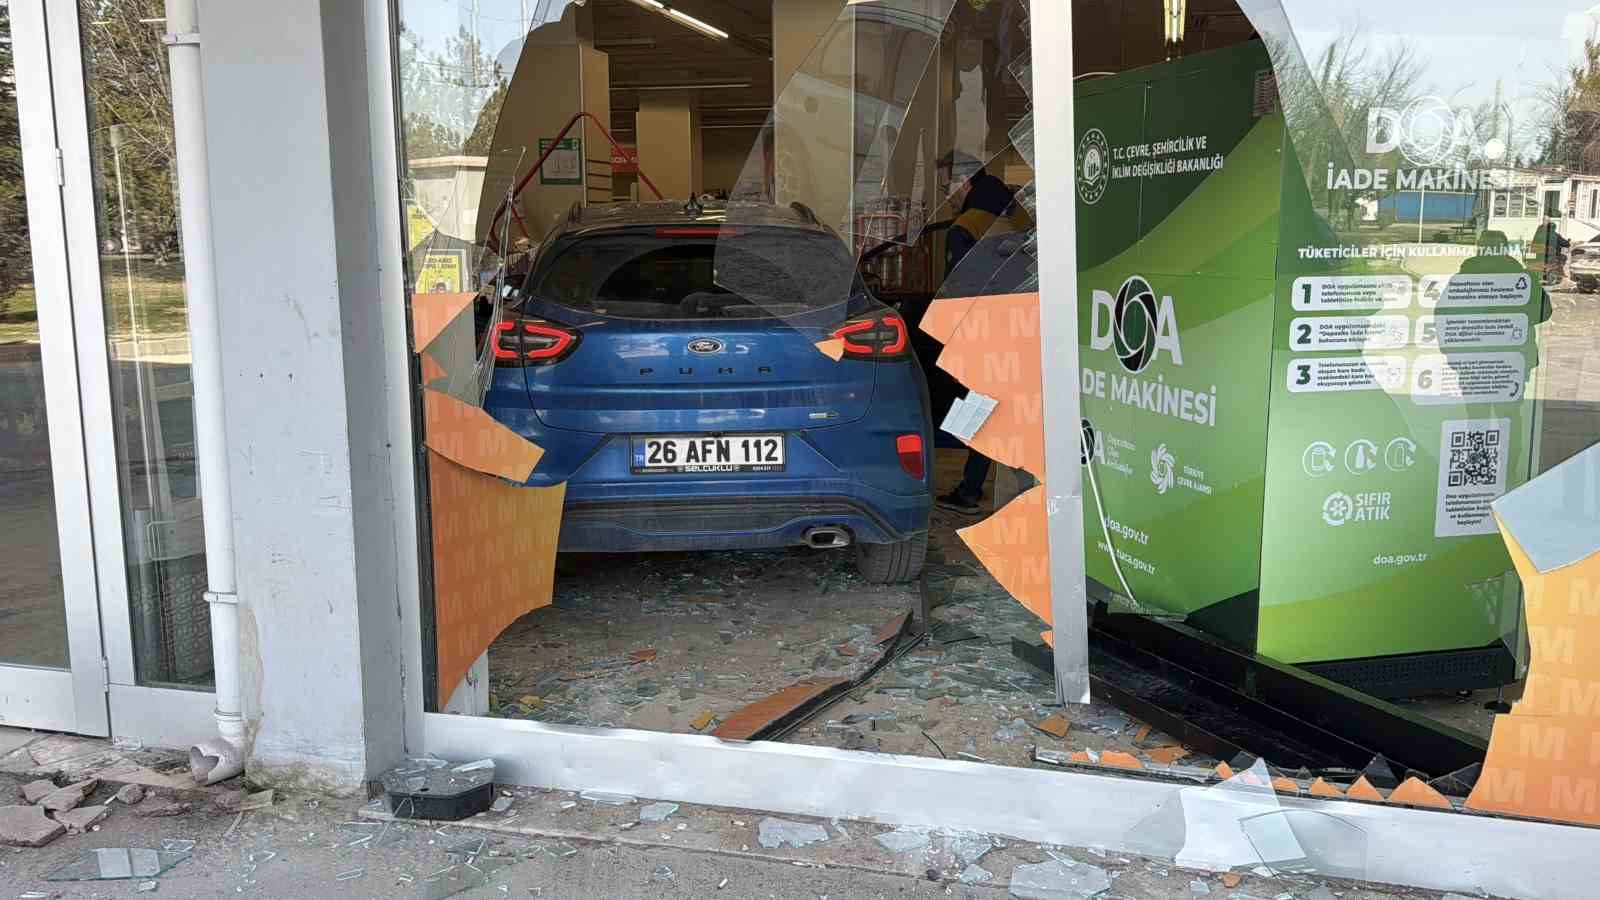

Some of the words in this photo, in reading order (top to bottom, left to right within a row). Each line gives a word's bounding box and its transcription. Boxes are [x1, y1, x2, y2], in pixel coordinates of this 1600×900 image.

[1152, 136, 1194, 157] ŞEHİRCİLİK
[1195, 136, 1208, 150] VE
[1176, 153, 1224, 173] BAKANLIĞI
[1327, 162, 1388, 190] İADE
[1298, 243, 1377, 259] TÜKETİCİLER
[1380, 243, 1405, 260] İÇİN
[1408, 245, 1474, 257] KULLANMA
[1302, 283, 1312, 304] 1
[1090, 275, 1183, 374] DOA
[1297, 324, 1312, 344] 2
[640, 366, 772, 377] PUMA
[1296, 365, 1311, 385] 3
[1418, 369, 1433, 389] 6
[1111, 374, 1217, 427] MAKİNESİ
[648, 440, 677, 464] 26
[686, 439, 730, 463] AFN
[741, 438, 778, 462] 112
[1355, 492, 1392, 506] SIFIR
[1354, 506, 1391, 521] ATIK
[1373, 553, 1428, 566] doa.gov.tr
